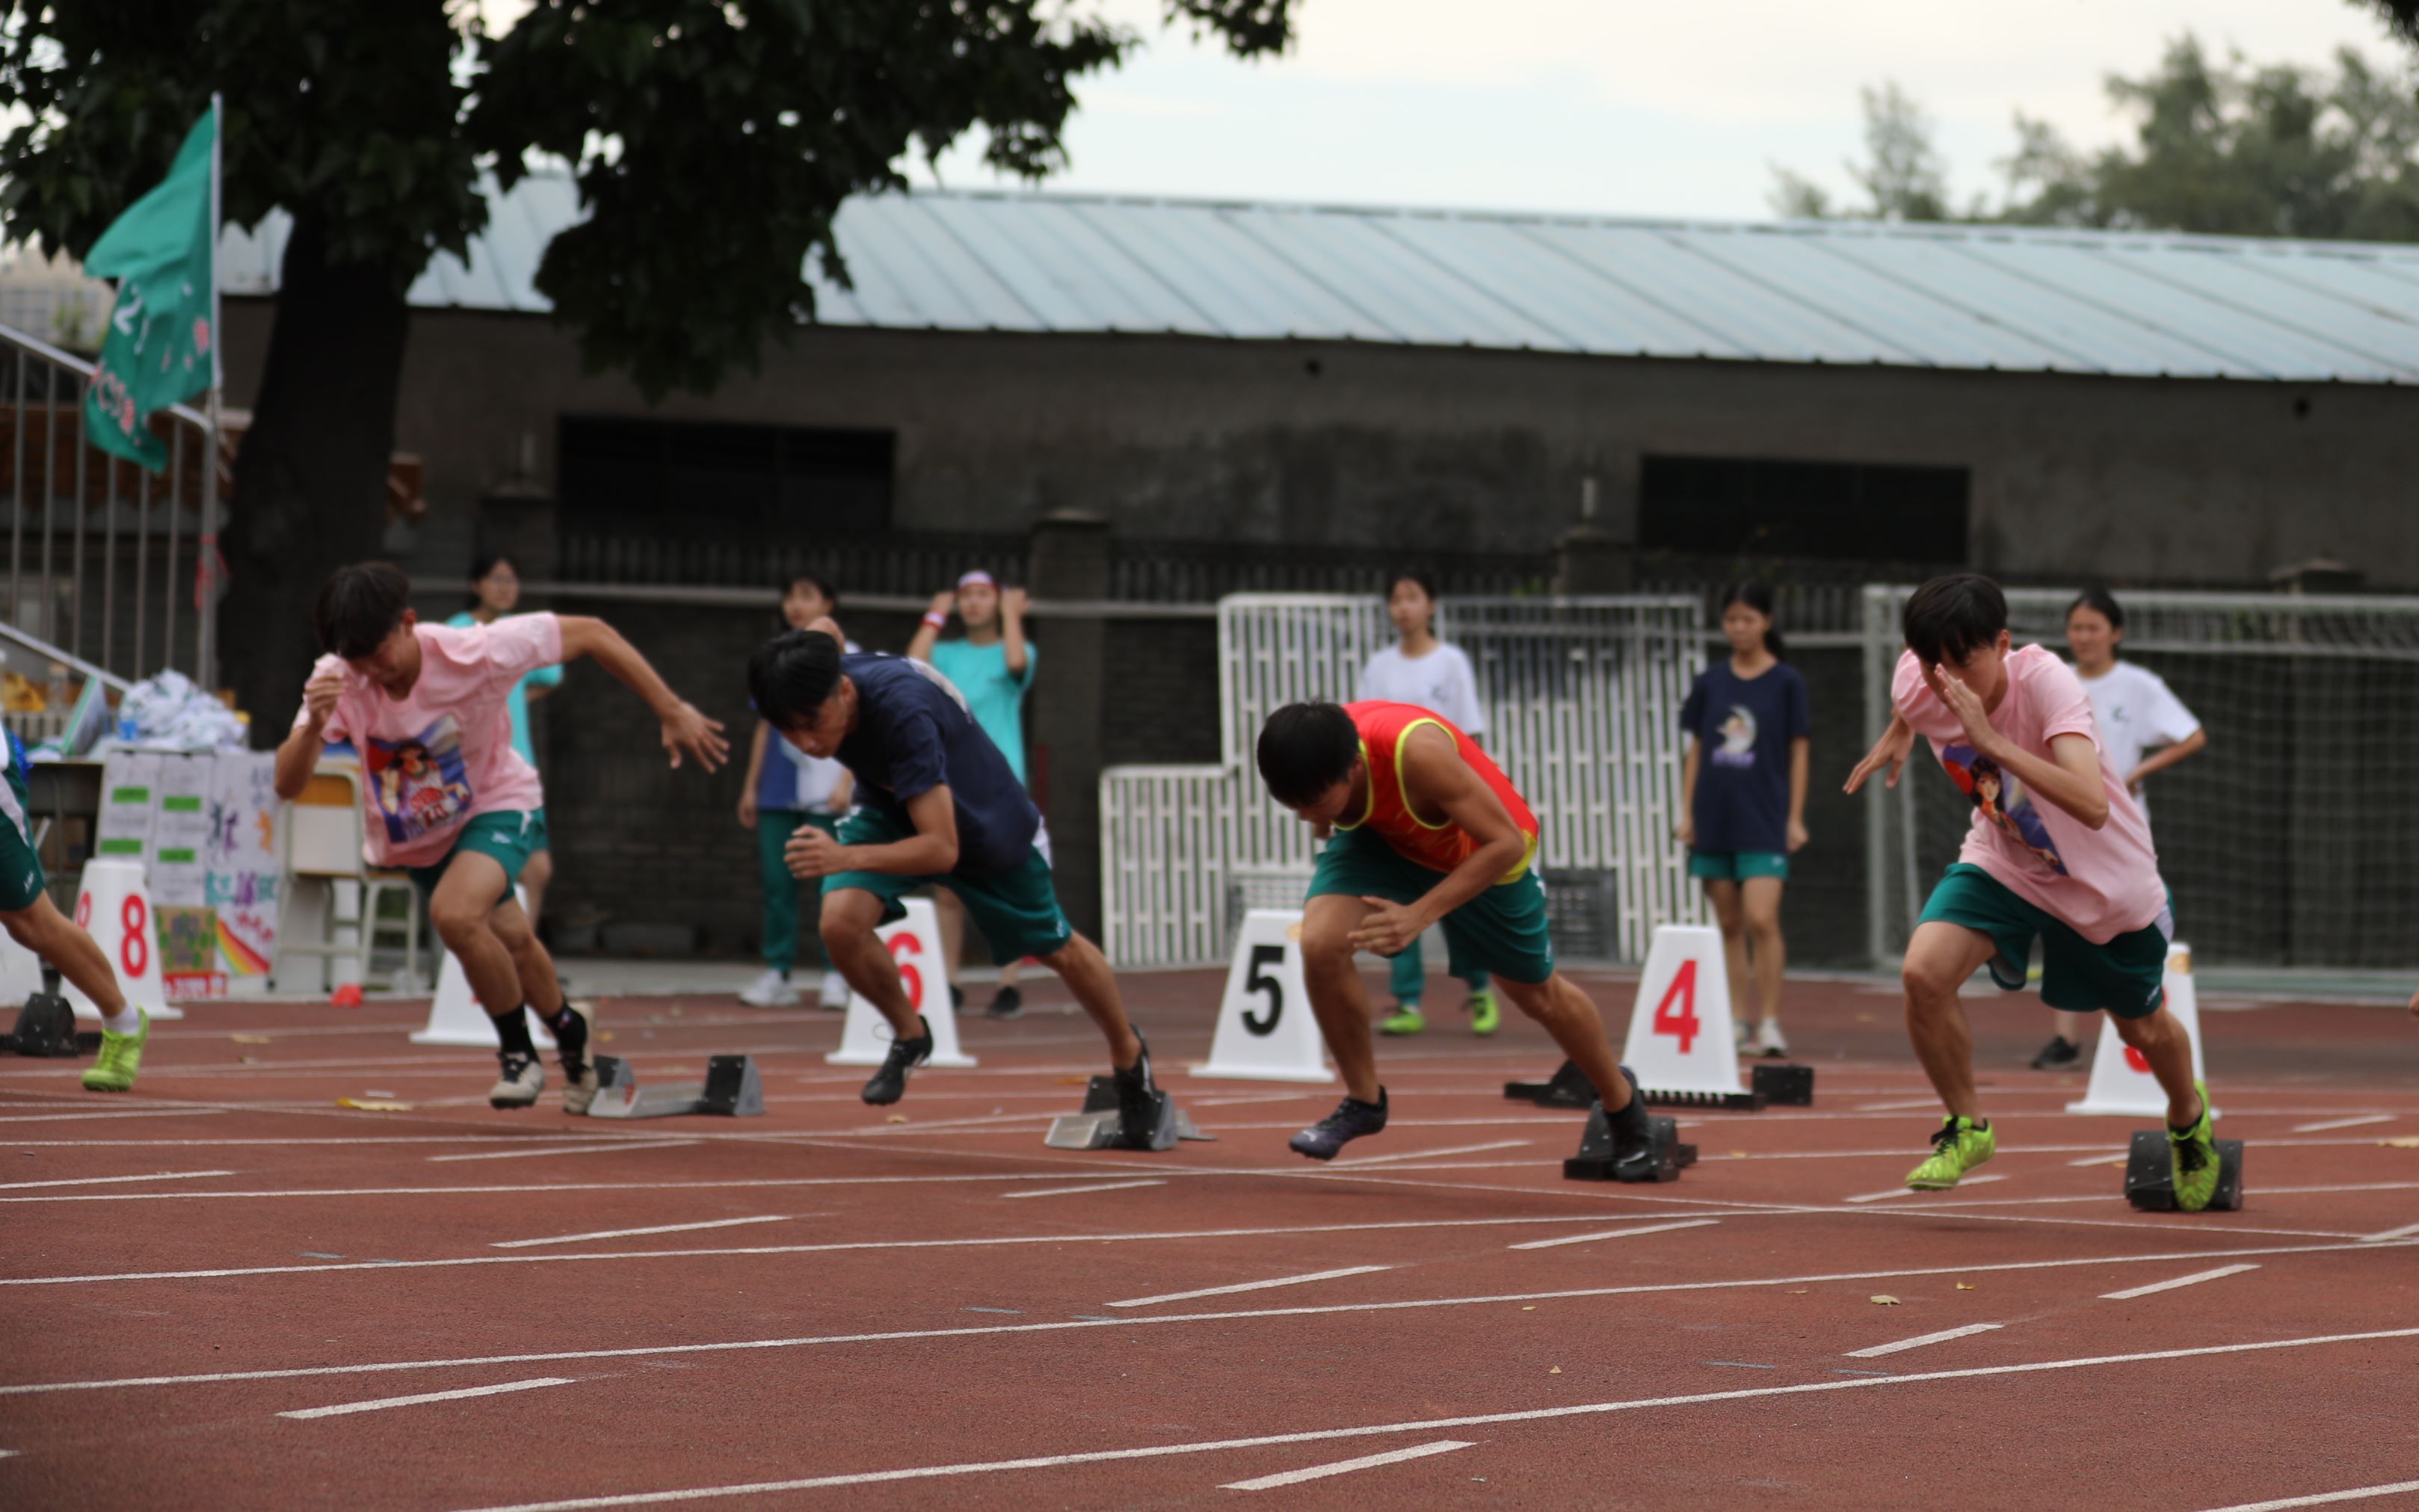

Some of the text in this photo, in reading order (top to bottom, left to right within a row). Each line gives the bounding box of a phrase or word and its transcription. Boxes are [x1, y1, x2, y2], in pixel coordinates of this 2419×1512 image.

[121, 893, 148, 979] 8
[1242, 945, 1285, 1037] 5
[1653, 959, 1700, 1054] 4
